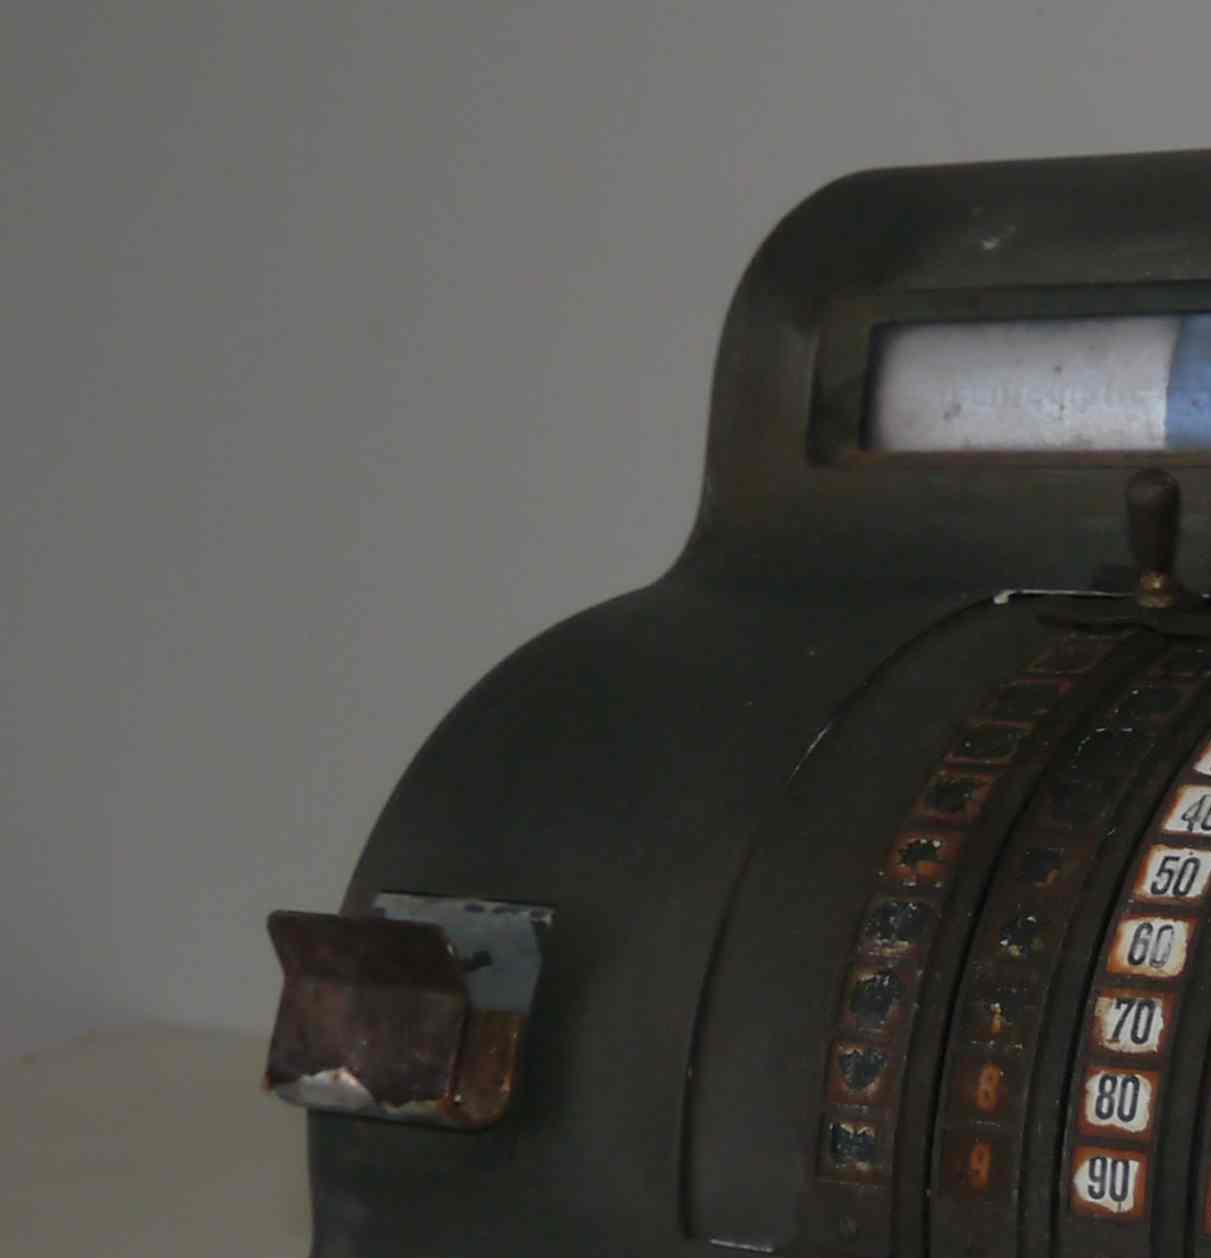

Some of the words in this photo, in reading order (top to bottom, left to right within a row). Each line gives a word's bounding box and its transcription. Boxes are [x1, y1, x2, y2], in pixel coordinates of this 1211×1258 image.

[1150, 856, 1201, 897] 50
[1127, 921, 1176, 968] 60
[1108, 997, 1156, 1045] 70
[1094, 1073, 1141, 1123] 80
[1087, 1155, 1131, 1203] 90
